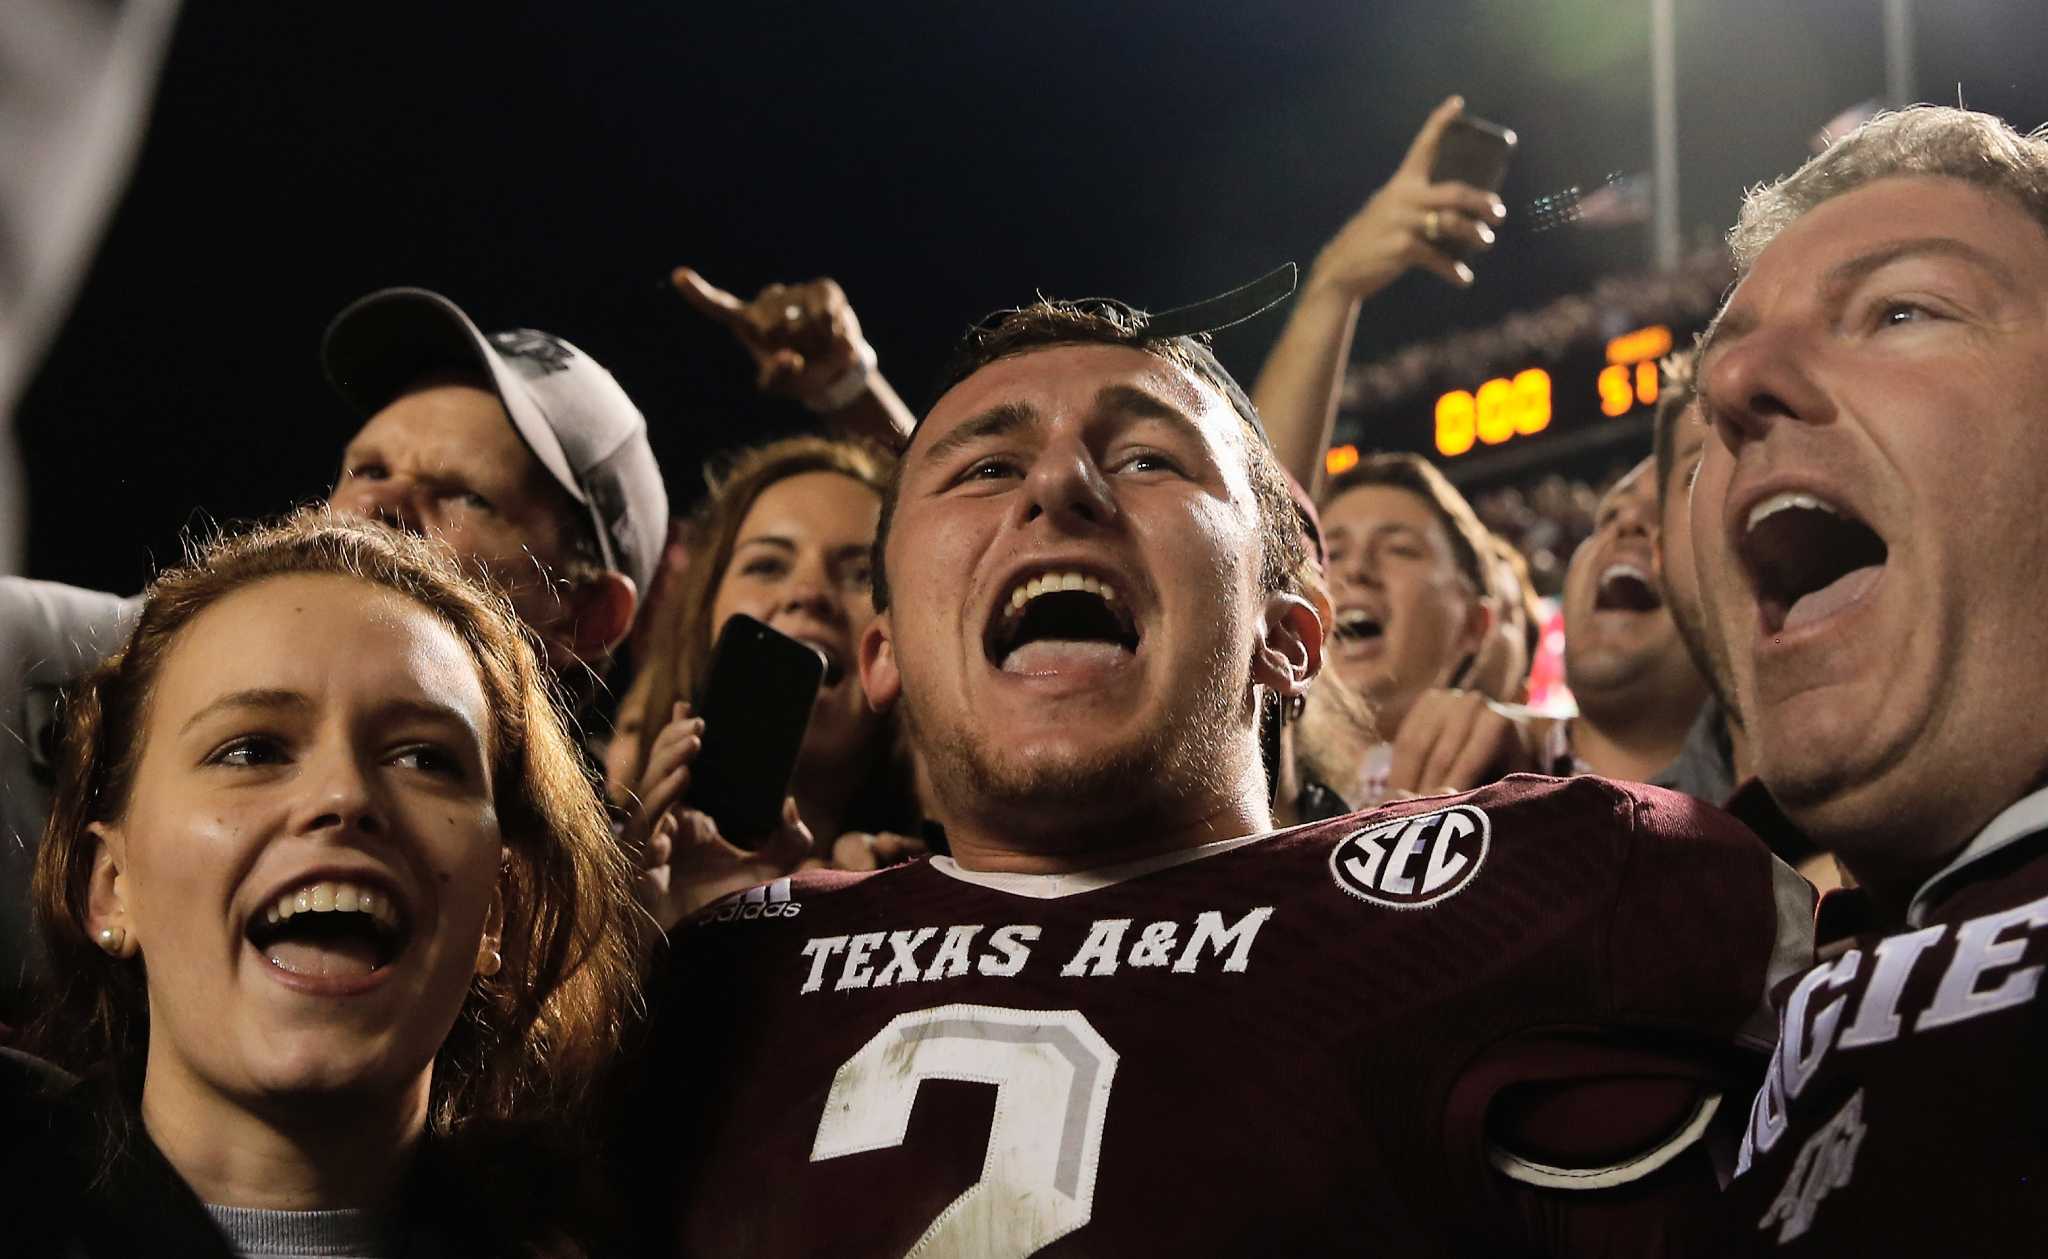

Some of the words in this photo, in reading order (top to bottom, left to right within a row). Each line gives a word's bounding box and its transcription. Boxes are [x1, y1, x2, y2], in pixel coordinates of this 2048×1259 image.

[1343, 811, 1476, 895] SEC
[800, 924, 1042, 996] TEXAS
[1060, 906, 1275, 978] A&M
[809, 1003, 1121, 1259] 2
